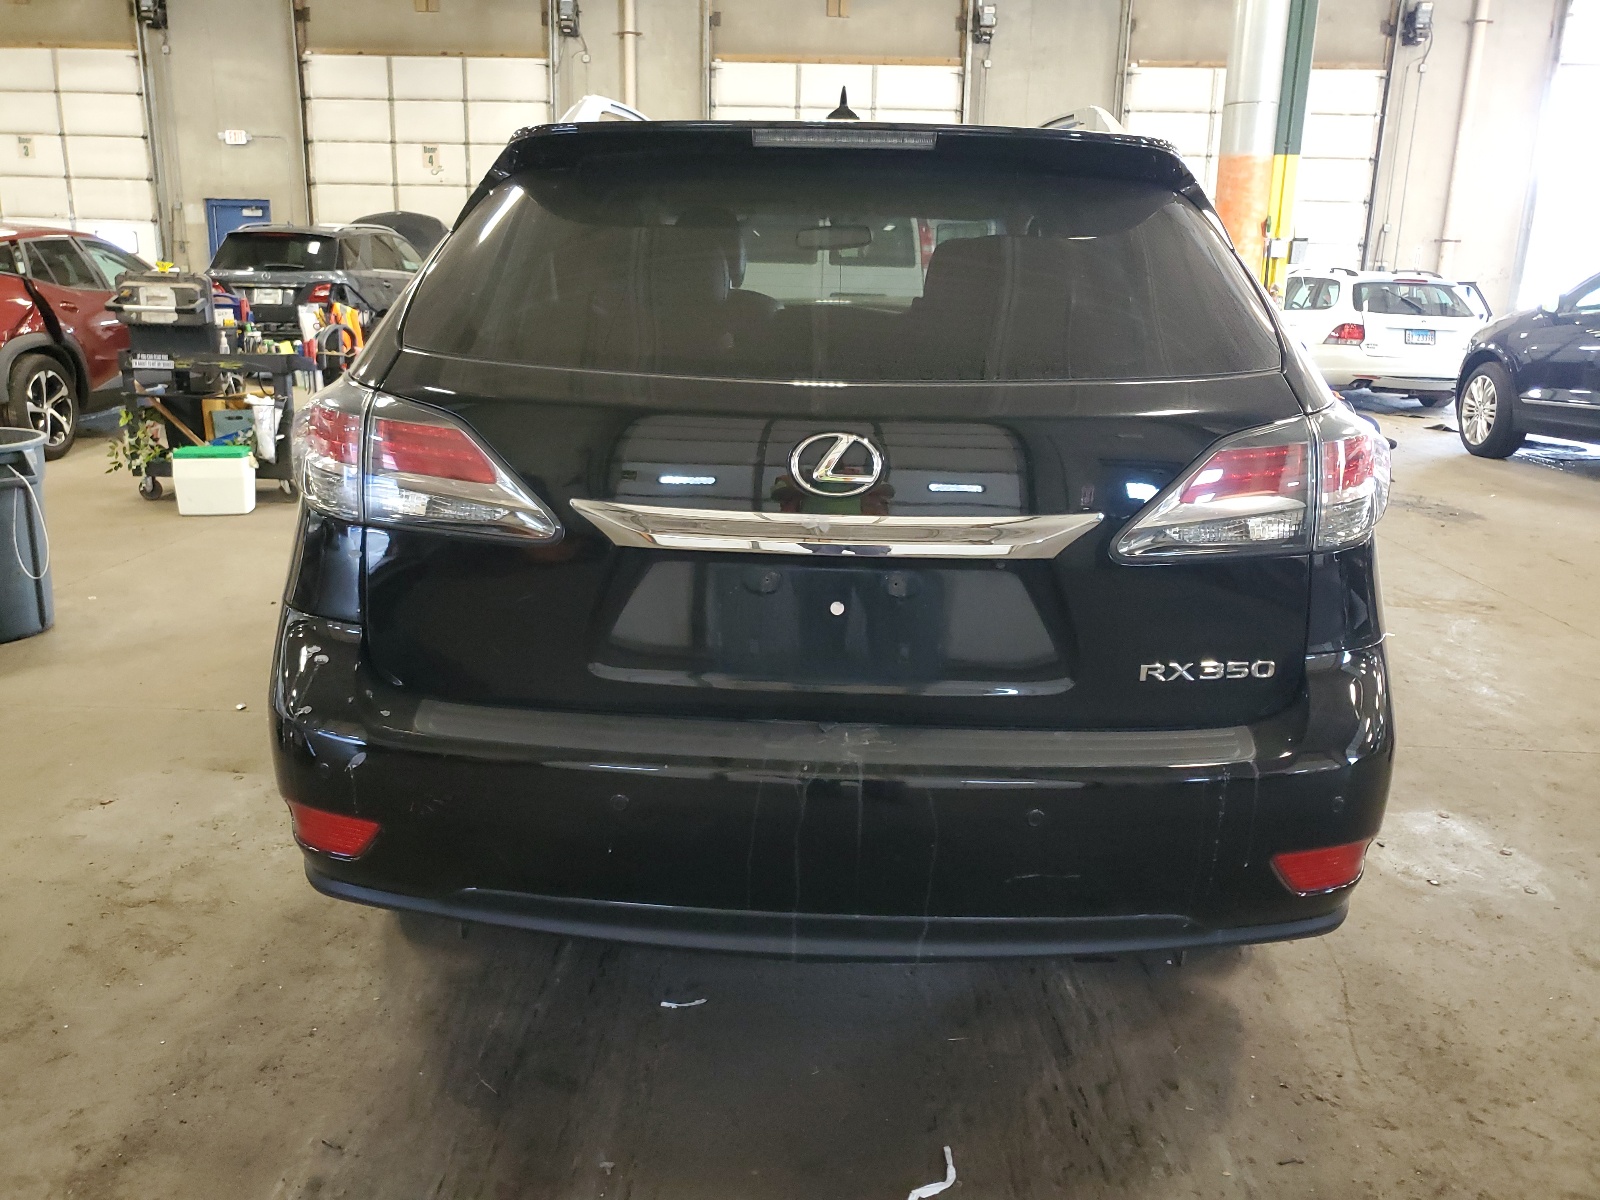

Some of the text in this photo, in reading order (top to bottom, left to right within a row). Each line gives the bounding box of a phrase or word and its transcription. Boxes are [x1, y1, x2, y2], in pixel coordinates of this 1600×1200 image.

[428, 155, 434, 166] 4
[1139, 659, 1276, 682] RX 350
